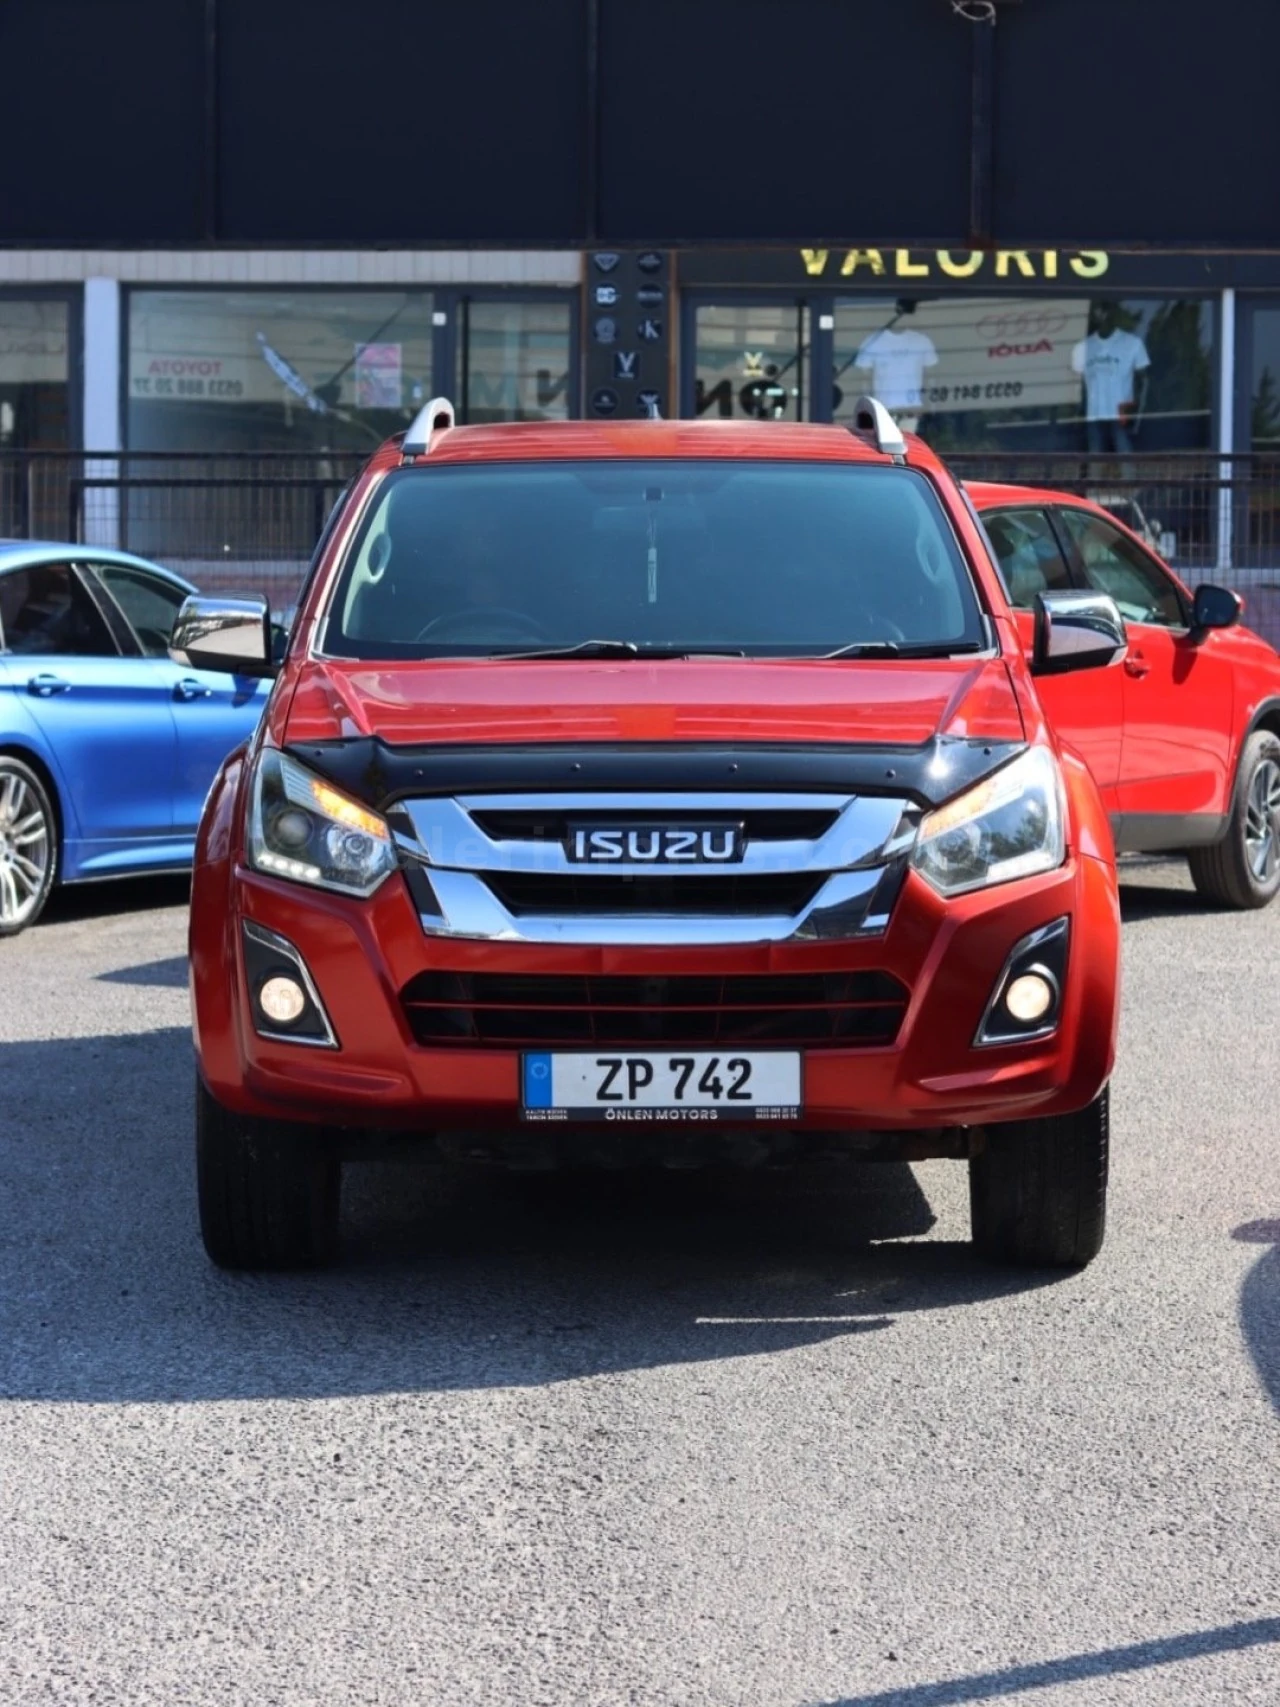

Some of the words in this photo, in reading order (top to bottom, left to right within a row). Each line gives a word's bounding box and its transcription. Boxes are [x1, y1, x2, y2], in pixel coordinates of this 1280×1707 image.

[800, 249, 1109, 277] VALORIS
[576, 831, 734, 858] ISUZU
[596, 1058, 653, 1100] ZP
[669, 1058, 752, 1100] 742
[604, 1107, 652, 1120] ÖNLEN
[656, 1109, 718, 1120] MOTORS
